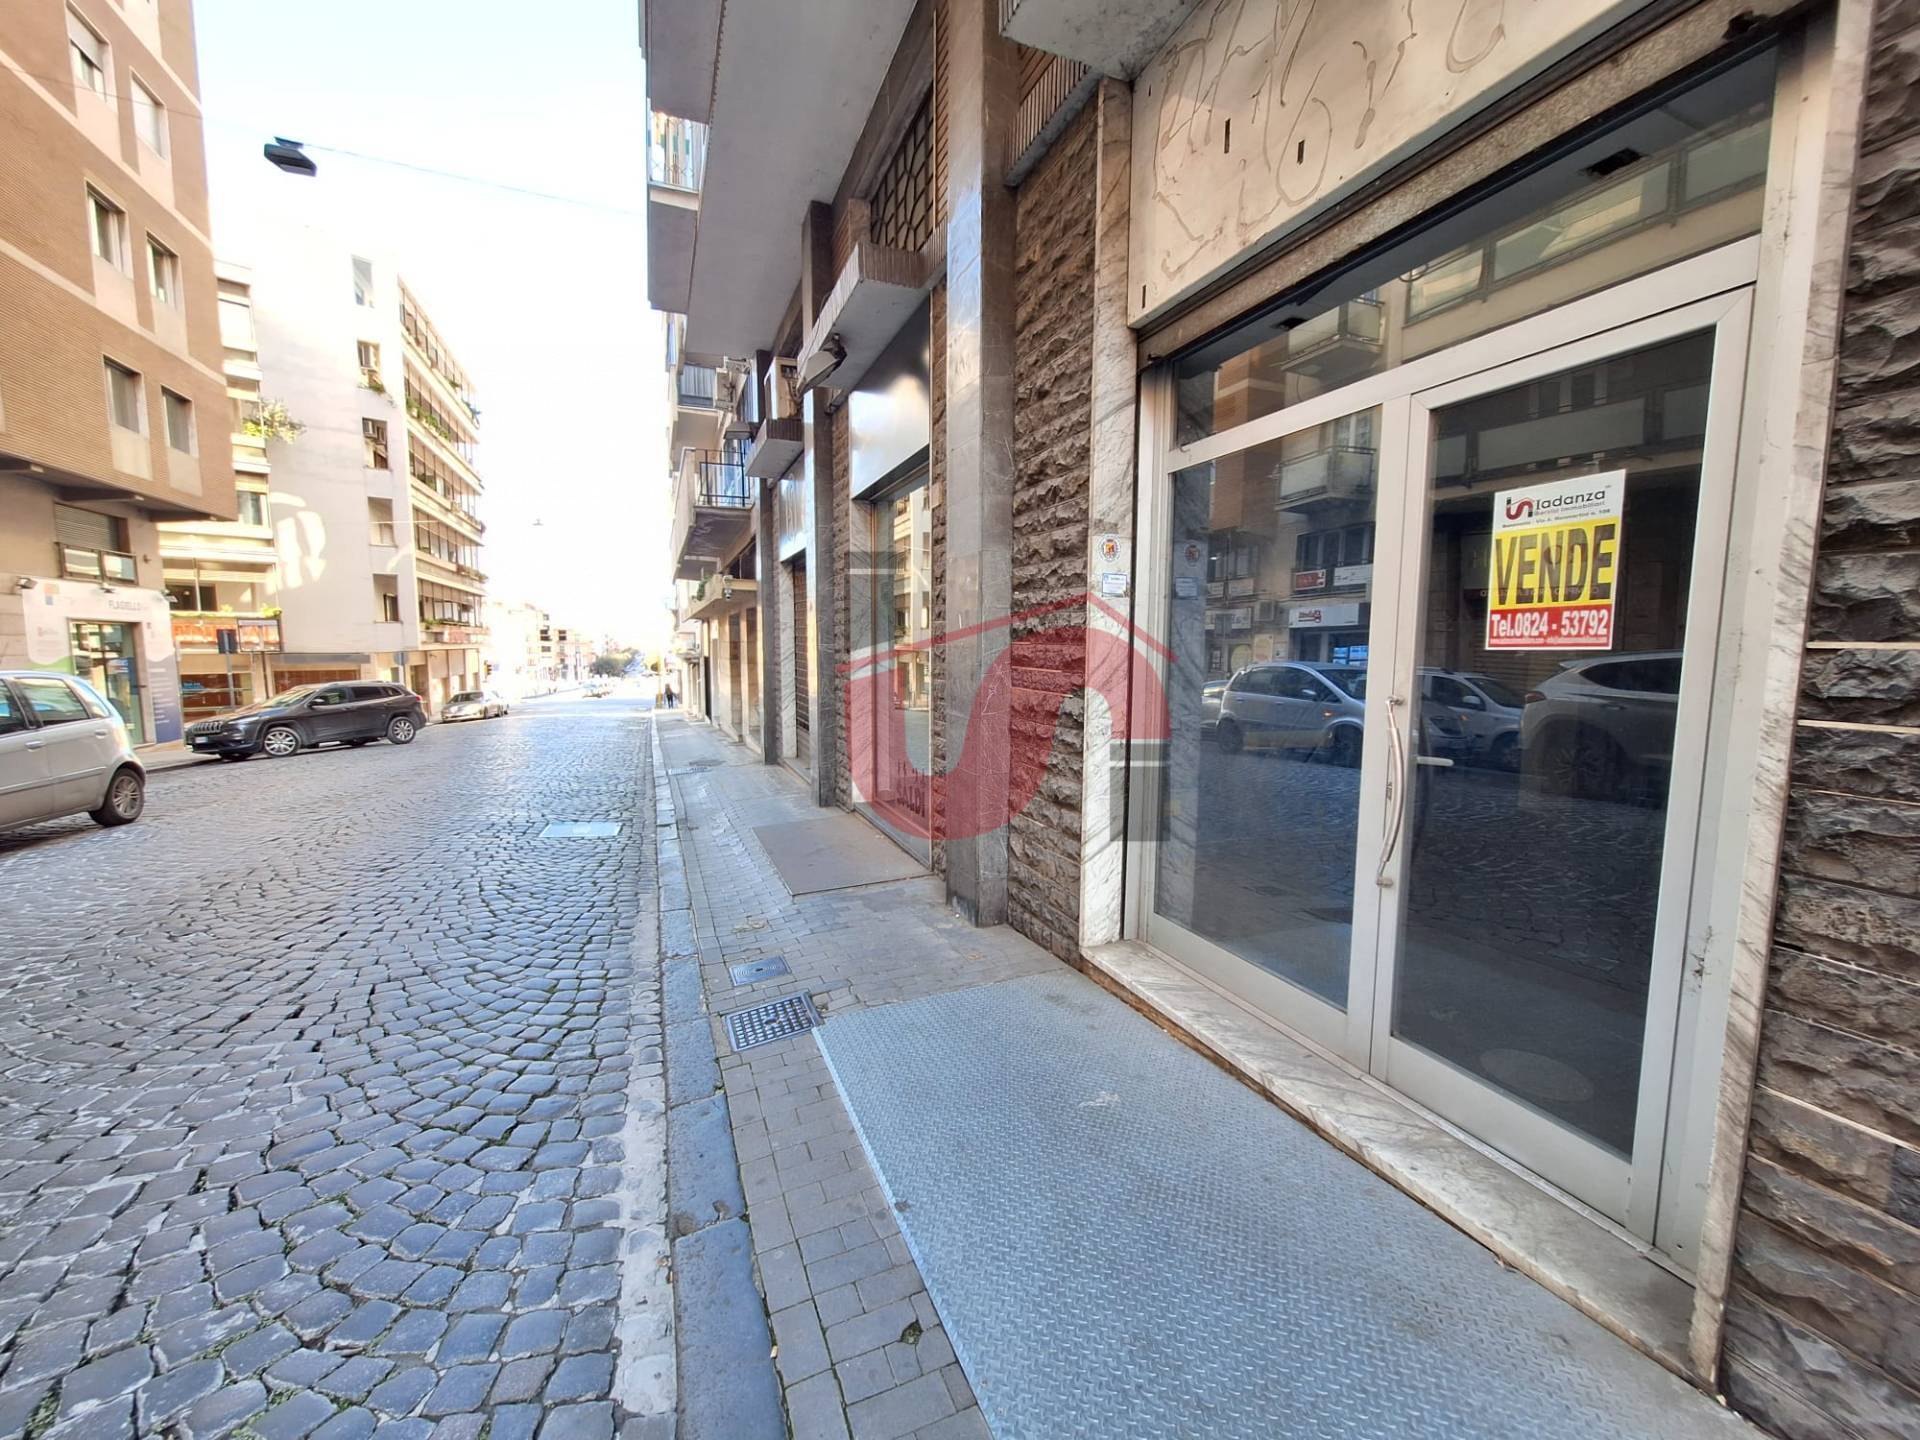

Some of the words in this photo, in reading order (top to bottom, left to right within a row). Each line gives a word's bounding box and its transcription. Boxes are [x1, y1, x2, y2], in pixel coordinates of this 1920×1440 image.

[1536, 490, 1606, 510] Iadanza
[1495, 524, 1616, 605] VENDE
[1491, 612, 1549, 637] Tel.0824
[1560, 609, 1609, 636] 53792
